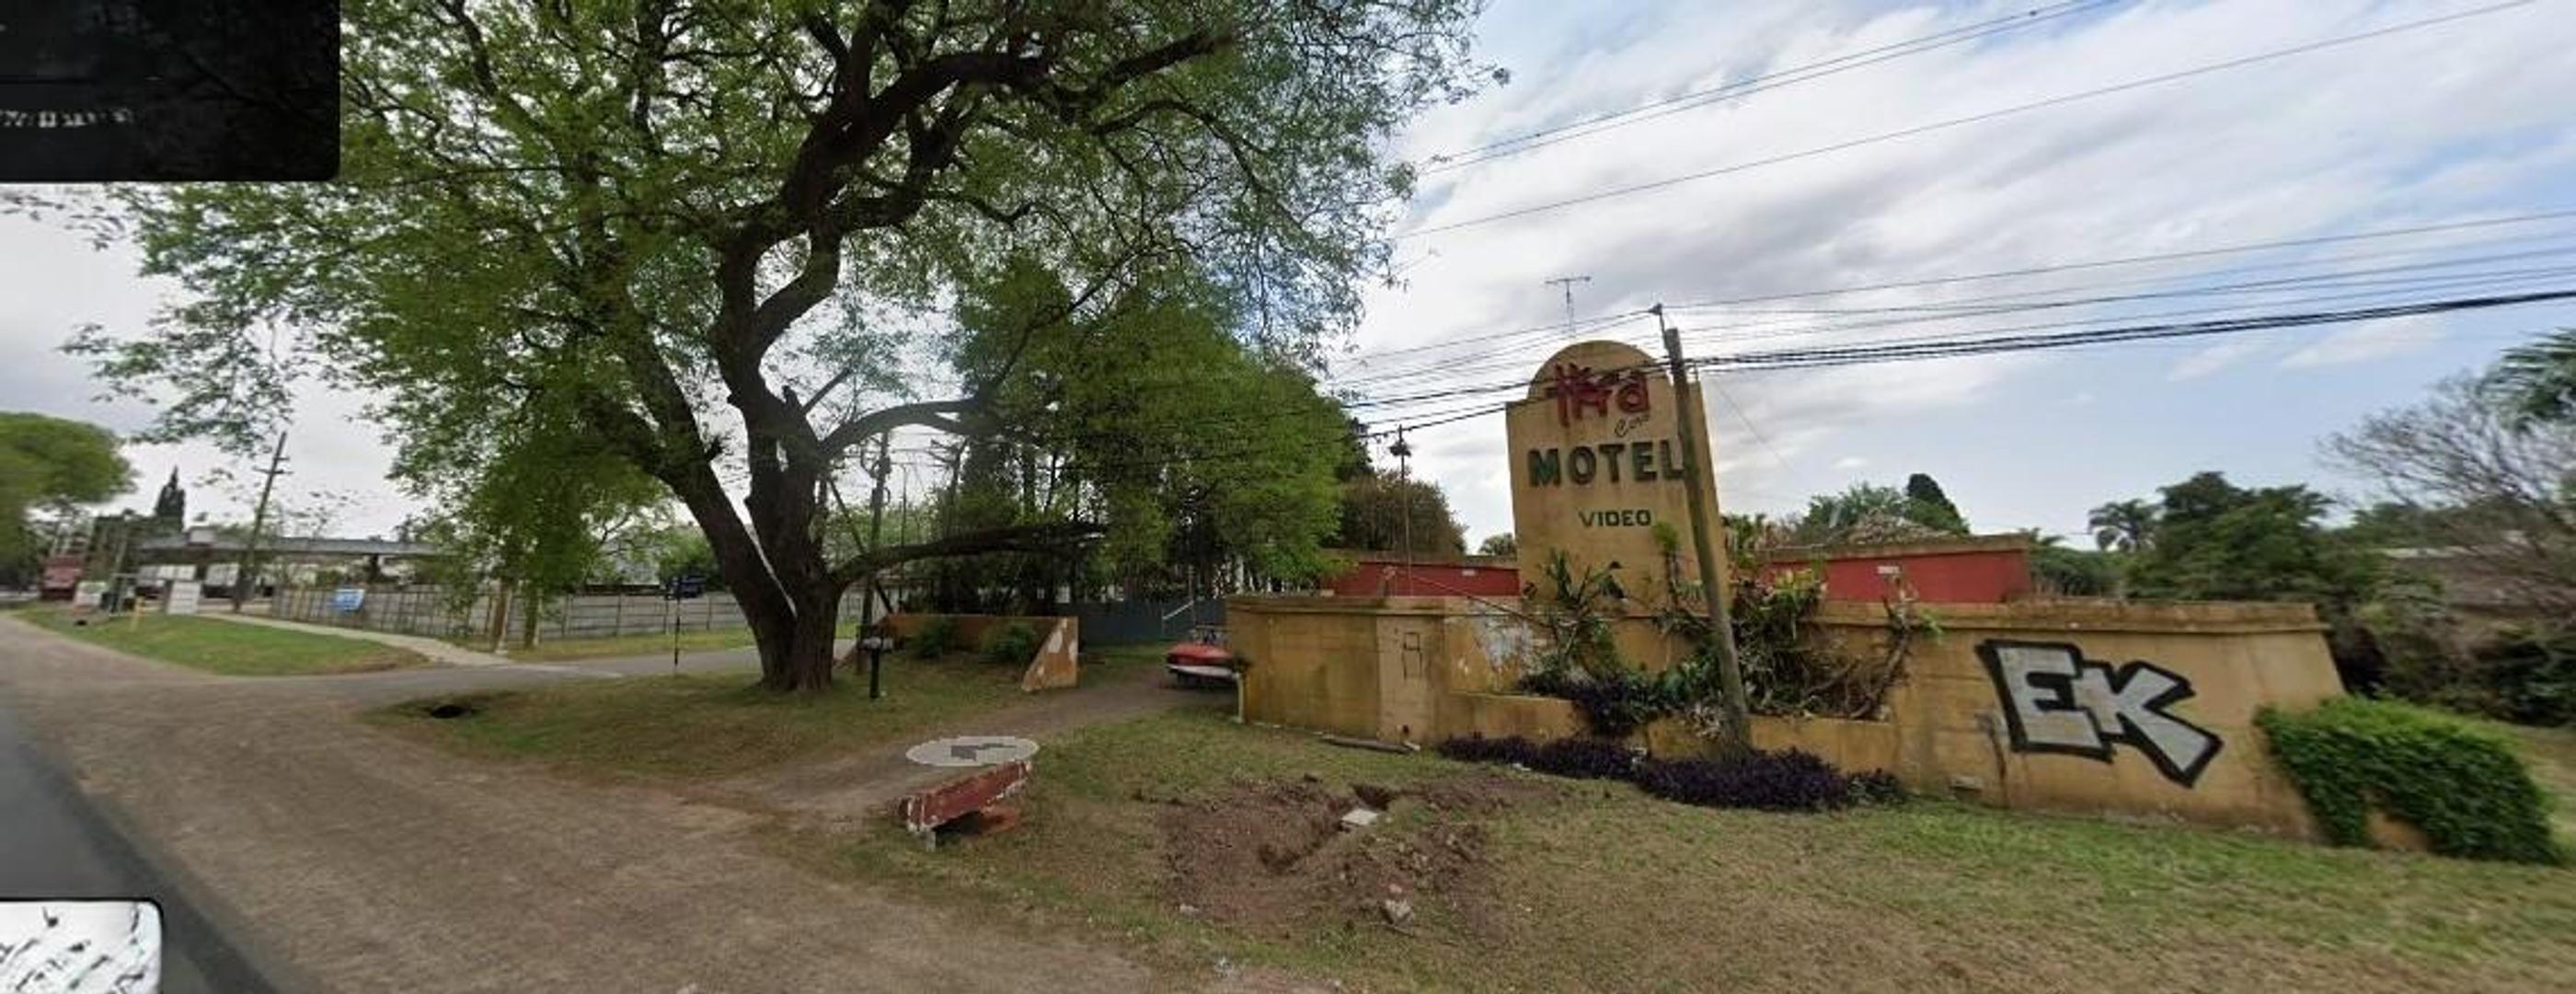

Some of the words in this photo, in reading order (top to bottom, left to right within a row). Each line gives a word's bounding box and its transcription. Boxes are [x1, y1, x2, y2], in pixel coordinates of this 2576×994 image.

[1527, 440, 1685, 489] MOTEL
[1578, 509, 1651, 527] VIDEO
[1974, 639, 2225, 789] EK
